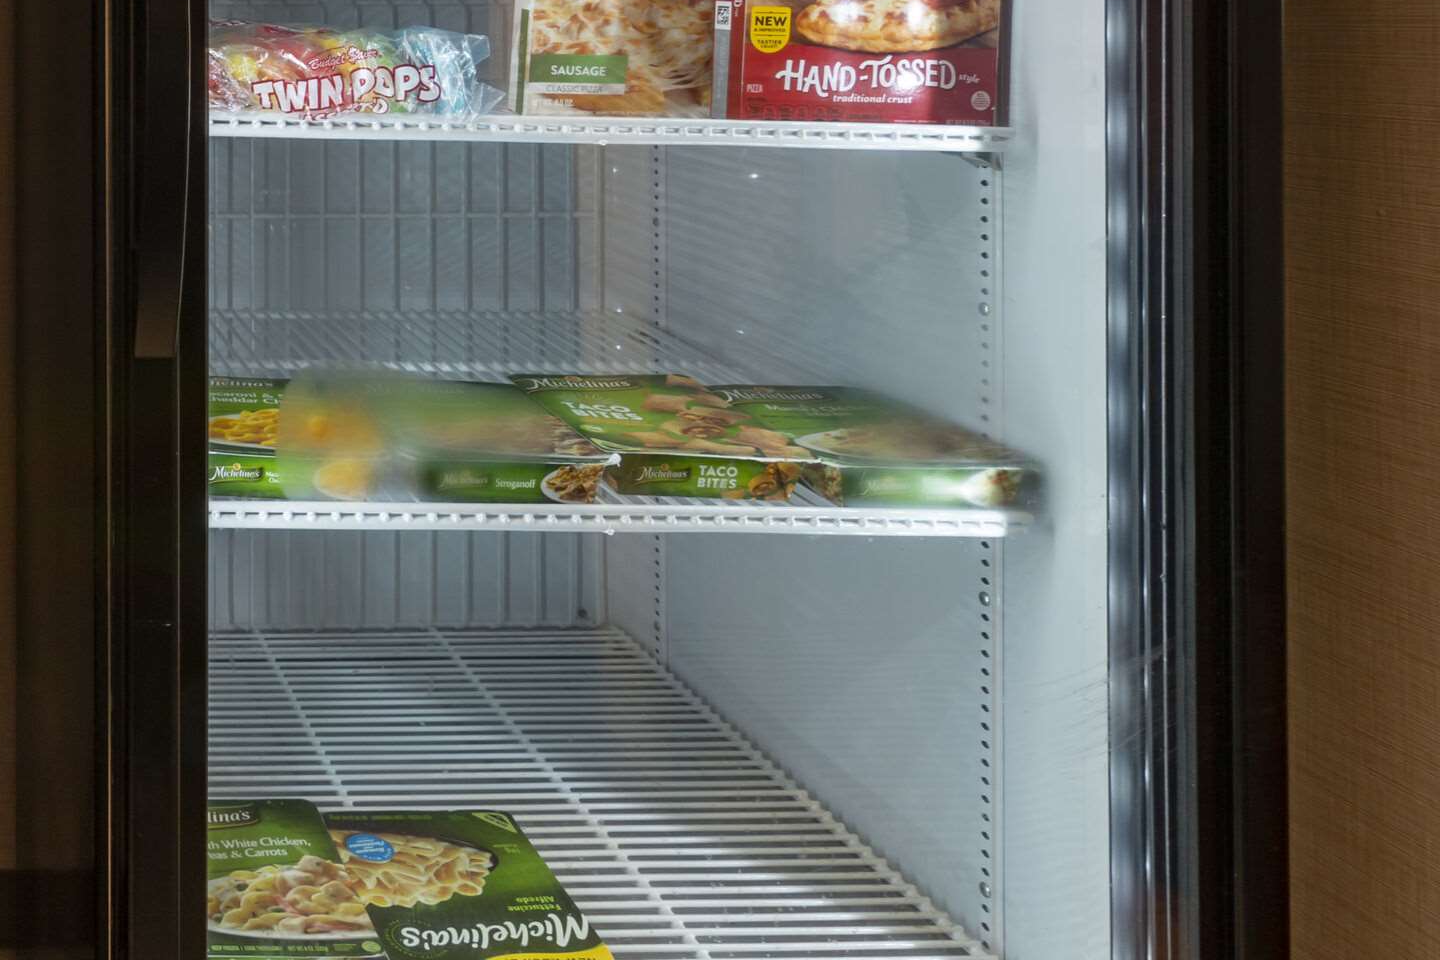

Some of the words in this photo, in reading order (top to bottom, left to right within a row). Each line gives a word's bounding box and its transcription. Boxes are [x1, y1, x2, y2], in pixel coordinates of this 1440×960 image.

[754, 16, 788, 27] NEW
[550, 64, 608, 78] SAUSAGE
[959, 73, 981, 85] style
[252, 70, 346, 113] TWIN
[350, 64, 443, 104] POPS
[832, 93, 885, 105] traditional
[887, 94, 913, 105] crust
[561, 400, 631, 413] TACO
[570, 410, 645, 422] BITES
[698, 464, 738, 478] TACO
[495, 477, 536, 490] Stroganoff
[696, 477, 738, 490] BITES
[221, 839, 258, 849] White
[259, 836, 312, 848] Chicken,
[231, 849, 242, 859] &
[244, 847, 288, 858] Carrots
[515, 895, 555, 904] Alfredo
[507, 903, 562, 912] Fettuccine
[402, 912, 590, 948] Michelina's
